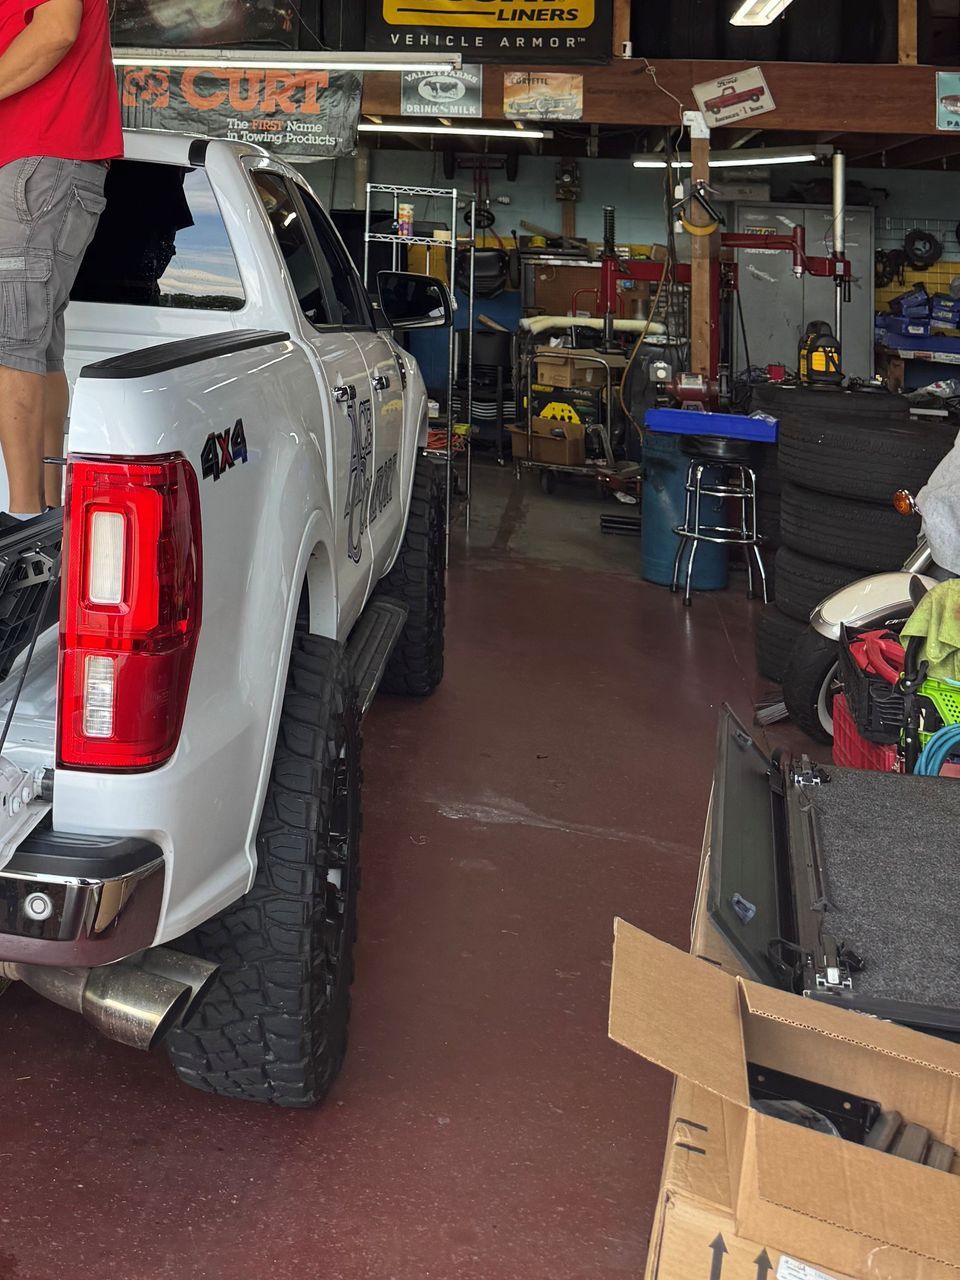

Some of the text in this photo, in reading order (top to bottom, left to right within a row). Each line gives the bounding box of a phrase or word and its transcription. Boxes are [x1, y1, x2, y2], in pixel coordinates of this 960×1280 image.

[497, 8, 579, 22] LINERS
[390, 33, 484, 47] VEHICLE
[181, 66, 330, 115] CURT
[406, 104, 439, 114] DRINK
[449, 105, 477, 114] MILK
[227, 119, 323, 133] The FIRST Name
[227, 131, 239, 141] in
[240, 131, 283, 145] Towing
